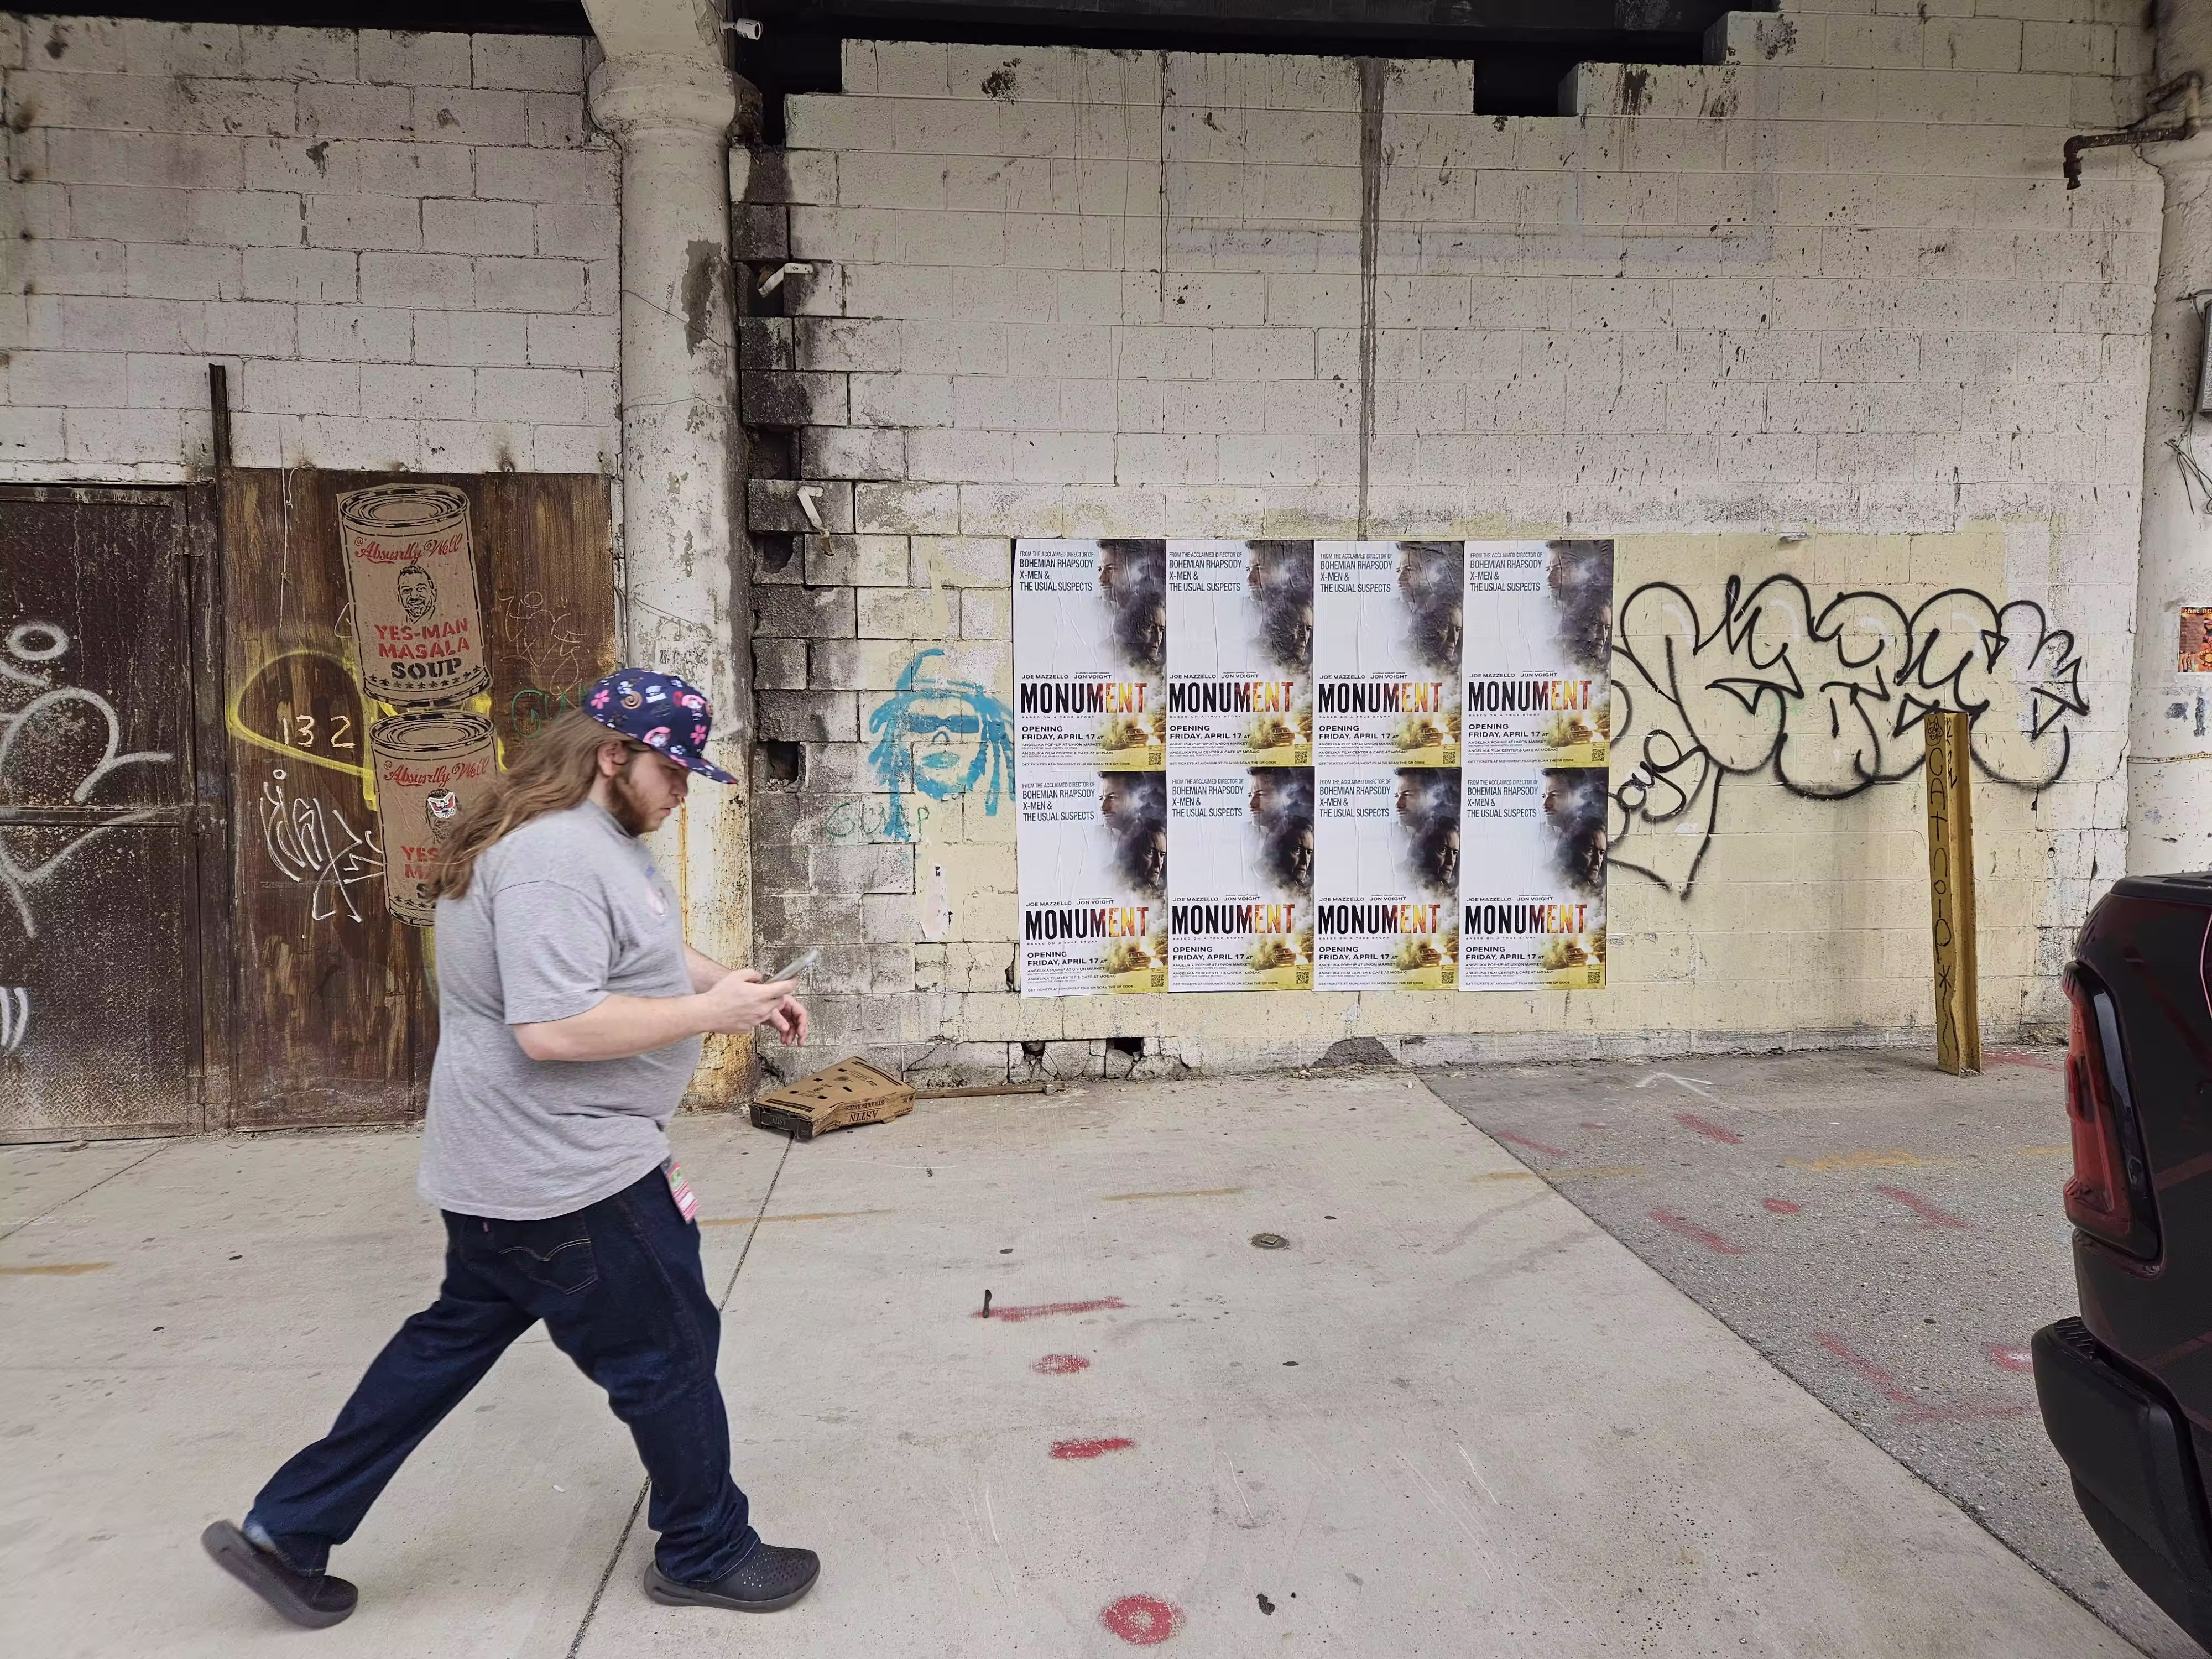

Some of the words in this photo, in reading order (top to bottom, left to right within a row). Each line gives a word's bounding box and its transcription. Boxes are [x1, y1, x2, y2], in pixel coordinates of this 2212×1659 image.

[1020, 559, 1056, 568] BOHEMIAN
[1057, 559, 1093, 568] RHAPSODY
[1169, 560, 1204, 568] BOHEMIAN
[1206, 560, 1242, 568] RHAPSODY
[1321, 561, 1355, 570] BOHEMIAN
[1357, 561, 1392, 570] RHAPSODY
[1470, 560, 1505, 568] BOHEMIAN
[1507, 560, 1542, 568] RHAPSODY
[1020, 570, 1042, 580] X-MEN
[1044, 570, 1050, 580] &
[1169, 571, 1192, 580] X-MEN
[1193, 571, 1198, 580] &
[1320, 572, 1343, 581] X-MEN
[1344, 572, 1349, 581] &
[1470, 571, 1493, 580] X-MEN
[1494, 571, 1499, 580] &
[1020, 582, 1033, 591] THE
[1035, 582, 1057, 591] USUAL
[1058, 582, 1093, 591] SUSPECTS
[1169, 583, 1182, 591] THE
[1183, 583, 1206, 591] USUAL
[1207, 582, 1240, 592] SUSPECTS
[1320, 584, 1333, 592] THE
[1334, 583, 1356, 592] USUAL
[1357, 583, 1391, 593] SUSPECTS
[1470, 583, 1483, 592] THE
[1484, 583, 1506, 591] USUAL
[1507, 582, 1541, 591] SUSPECTS
[374, 617, 468, 641] YES-MAN
[378, 637, 469, 660] MASALA
[390, 657, 462, 680] SOUP
[1020, 681, 1147, 714] MONUMENT
[1169, 681, 1293, 713] MONUMENT
[1318, 682, 1442, 713] MONUMENT
[1468, 680, 1592, 712] MONUMENT
[1022, 790, 1058, 799] BOHEMIAN
[1060, 789, 1095, 798] RHAPSODY
[1172, 786, 1207, 795] BOHEMIAN
[1209, 786, 1244, 795] RHAPSODY
[1320, 786, 1354, 795] BOHEMIAN
[1356, 786, 1390, 795] RHAPSODY
[1468, 787, 1502, 795] BOHEMIAN
[1504, 787, 1538, 795] RHAPSODY
[1022, 801, 1045, 810] X-MEN
[1047, 801, 1052, 810] &
[1172, 797, 1194, 806] X-MEN
[1196, 797, 1201, 806] &
[1319, 797, 1342, 806] X-MEN
[1343, 797, 1348, 806] &
[1467, 798, 1489, 806] X-MEN
[1490, 798, 1496, 806] &
[1023, 813, 1036, 822] THE
[1037, 812, 1059, 821] USUAL
[1061, 811, 1094, 821] SUSPECTS
[1172, 808, 1185, 817] THE
[1186, 808, 1208, 817] USUAL
[1209, 808, 1243, 817] SUSPECTS
[1319, 809, 1332, 817] THE
[1333, 808, 1355, 817] USUAL
[1356, 808, 1389, 817] SUSPECTS
[1467, 809, 1479, 817] THE
[1481, 809, 1502, 817] USUAL
[1504, 809, 1537, 817] SUSPECTS
[1025, 906, 1150, 940] MONUMENT
[1172, 904, 1295, 935] MONUMENT
[1318, 904, 1441, 935] MONUMENT
[1465, 904, 1587, 935] MONUMENT
[849, 1109, 880, 1122] ASTIN
